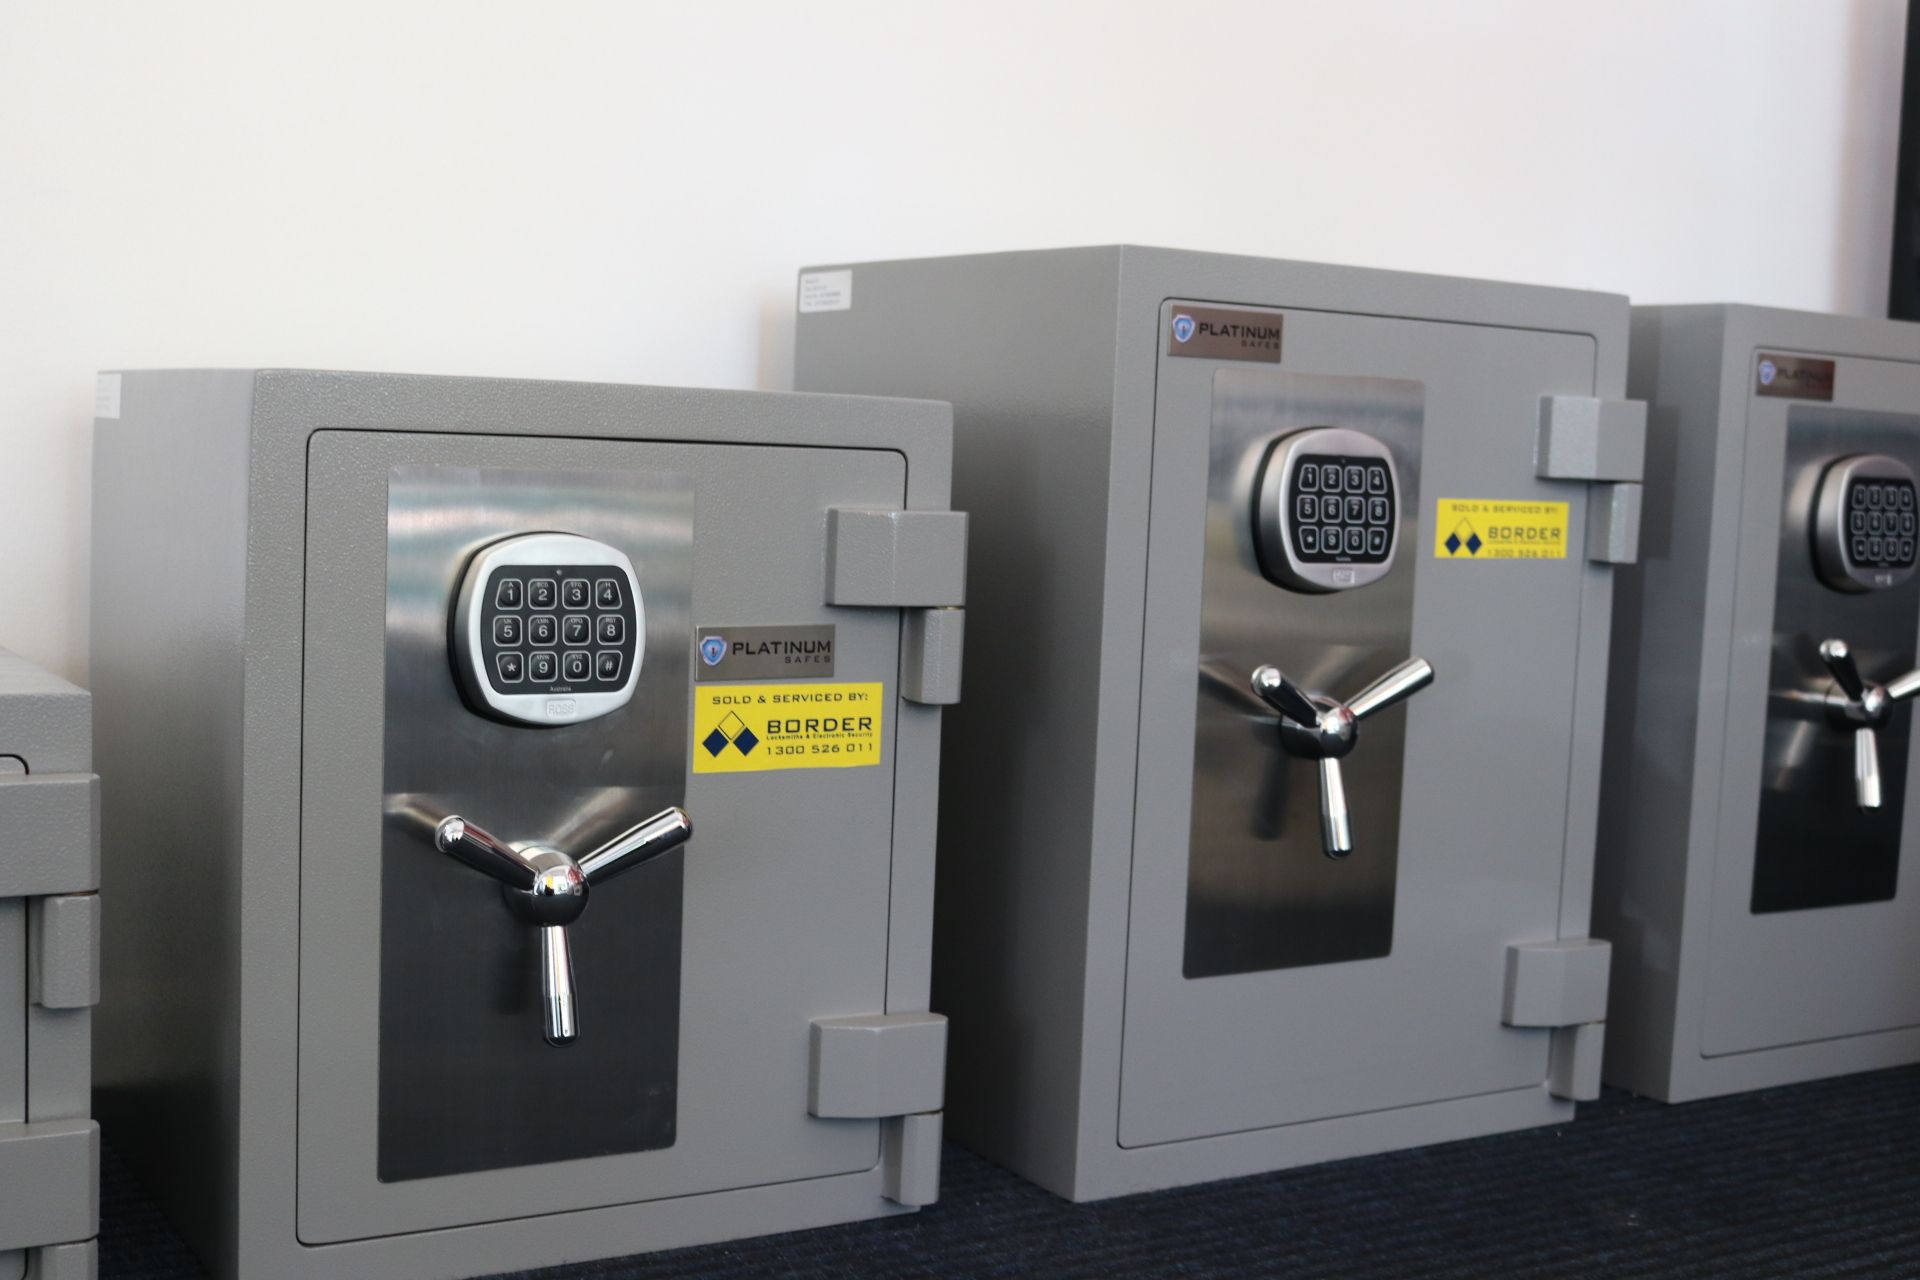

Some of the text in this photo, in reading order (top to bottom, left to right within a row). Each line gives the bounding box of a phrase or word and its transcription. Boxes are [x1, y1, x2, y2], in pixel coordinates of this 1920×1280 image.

[1199, 322, 1280, 340] PLATINUM
[1328, 474, 1336, 485] 2
[1351, 474, 1359, 486] 3
[1304, 504, 1312, 515] 5
[1352, 505, 1359, 516] 7
[1488, 526, 1561, 540] BORDER
[507, 588, 612, 601] 1 2 3 4
[503, 624, 616, 638] 5 6 7 8
[732, 640, 832, 655] PLATINUM
[784, 656, 831, 664] SAFES
[538, 661, 548, 674] 9
[572, 660, 582, 673] 0
[712, 693, 868, 705] SOLD & SERVICED BY:
[767, 717, 872, 734] BORDER
[767, 743, 873, 756] 1300 526 011
